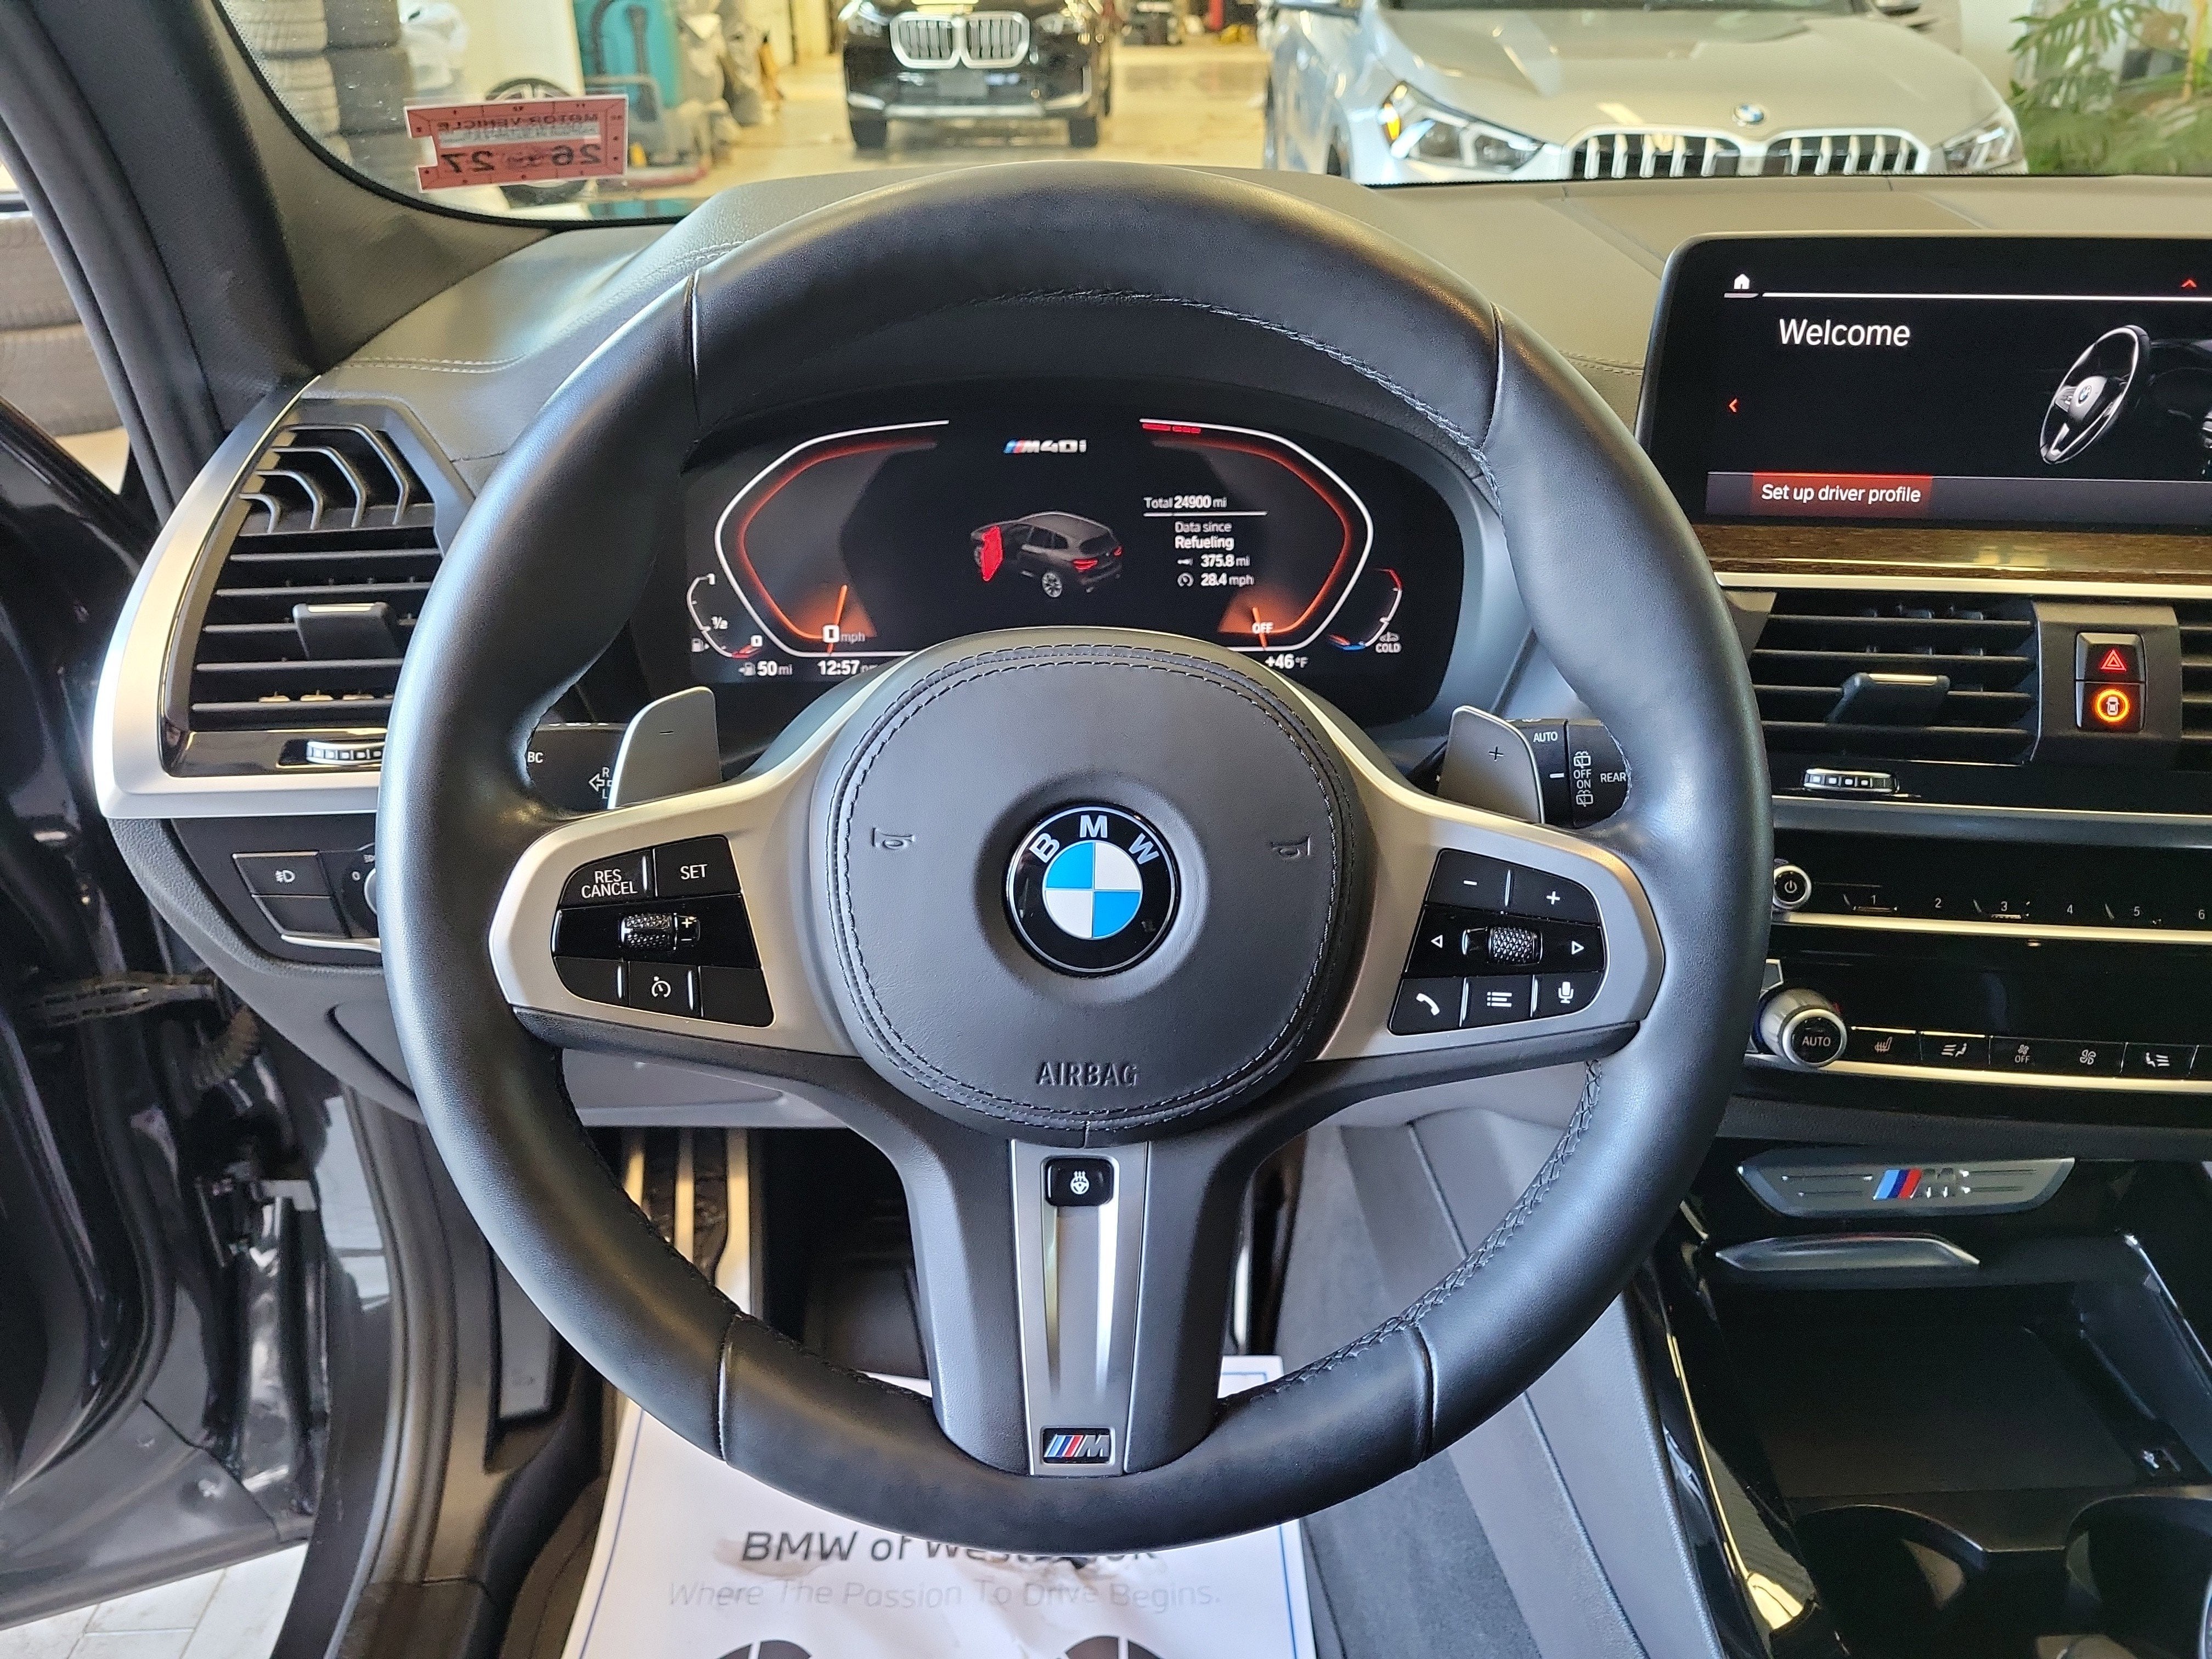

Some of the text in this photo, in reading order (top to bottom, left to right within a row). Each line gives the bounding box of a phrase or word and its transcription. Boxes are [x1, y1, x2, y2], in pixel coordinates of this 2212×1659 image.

[1779, 318, 1911, 347] Welcome
[1762, 484, 1921, 504] Set up driver profile
[1143, 495, 1227, 509] Total 24900 mi
[1175, 521, 1232, 533] Data since
[1175, 535, 1234, 550] Refueling
[1200, 554, 1250, 567] 375.8 mi
[1200, 573, 1255, 587] 28.4 mph
[822, 624, 865, 642] 0 mph
[1252, 622, 1274, 634] OFF
[751, 635, 763, 647] 0
[1375, 643, 1402, 653] COLD
[757, 661, 777, 676] 50
[817, 659, 860, 675] 12:57
[1533, 731, 1558, 743] AUTO
[527, 751, 544, 764] BC
[602, 767, 610, 777] R
[1573, 769, 1592, 780] OFF
[1600, 771, 1626, 783] REAR
[1576, 779, 1591, 789] ON
[1029, 815, 1159, 865] BMW
[595, 868, 622, 883] RES
[680, 864, 708, 880] SET
[582, 881, 638, 899] CANCEL
[1871, 895, 2205, 920] 1 2 3 4 5 6
[1802, 1036, 1831, 1047] AUTO
[2014, 1054, 2030, 1064] OFF
[1036, 1061, 1137, 1088] AIRBAG
[742, 1531, 858, 1561] BMW
[670, 1578, 1221, 1613] Where The Passion To Drive Begins.
